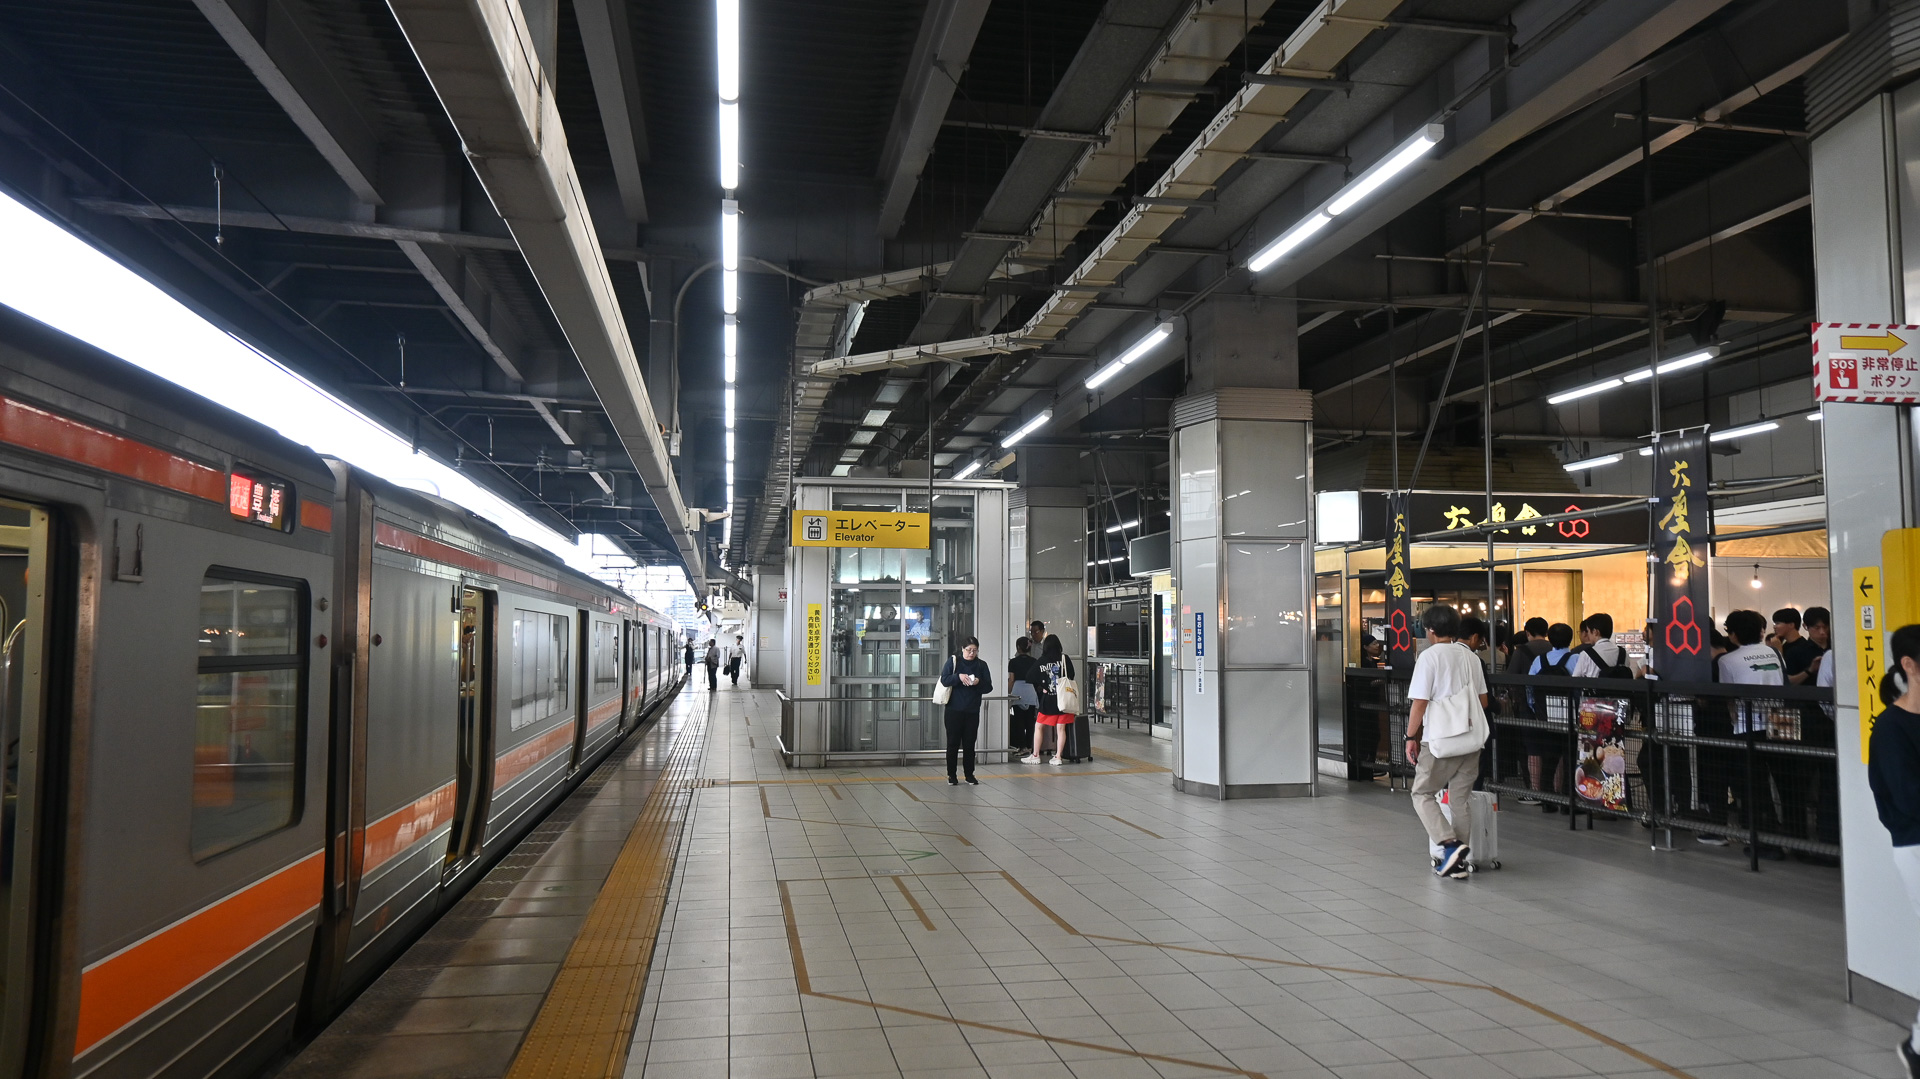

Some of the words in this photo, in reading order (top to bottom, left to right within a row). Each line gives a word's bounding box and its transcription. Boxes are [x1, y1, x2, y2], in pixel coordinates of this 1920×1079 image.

[1831, 360, 1855, 369] SOS
[1862, 357, 1918, 371] 非常停止
[1871, 374, 1911, 387] ボタン
[835, 518, 921, 531] エレベーター
[835, 533, 875, 541] Elevator
[716, 599, 723, 607] 2
